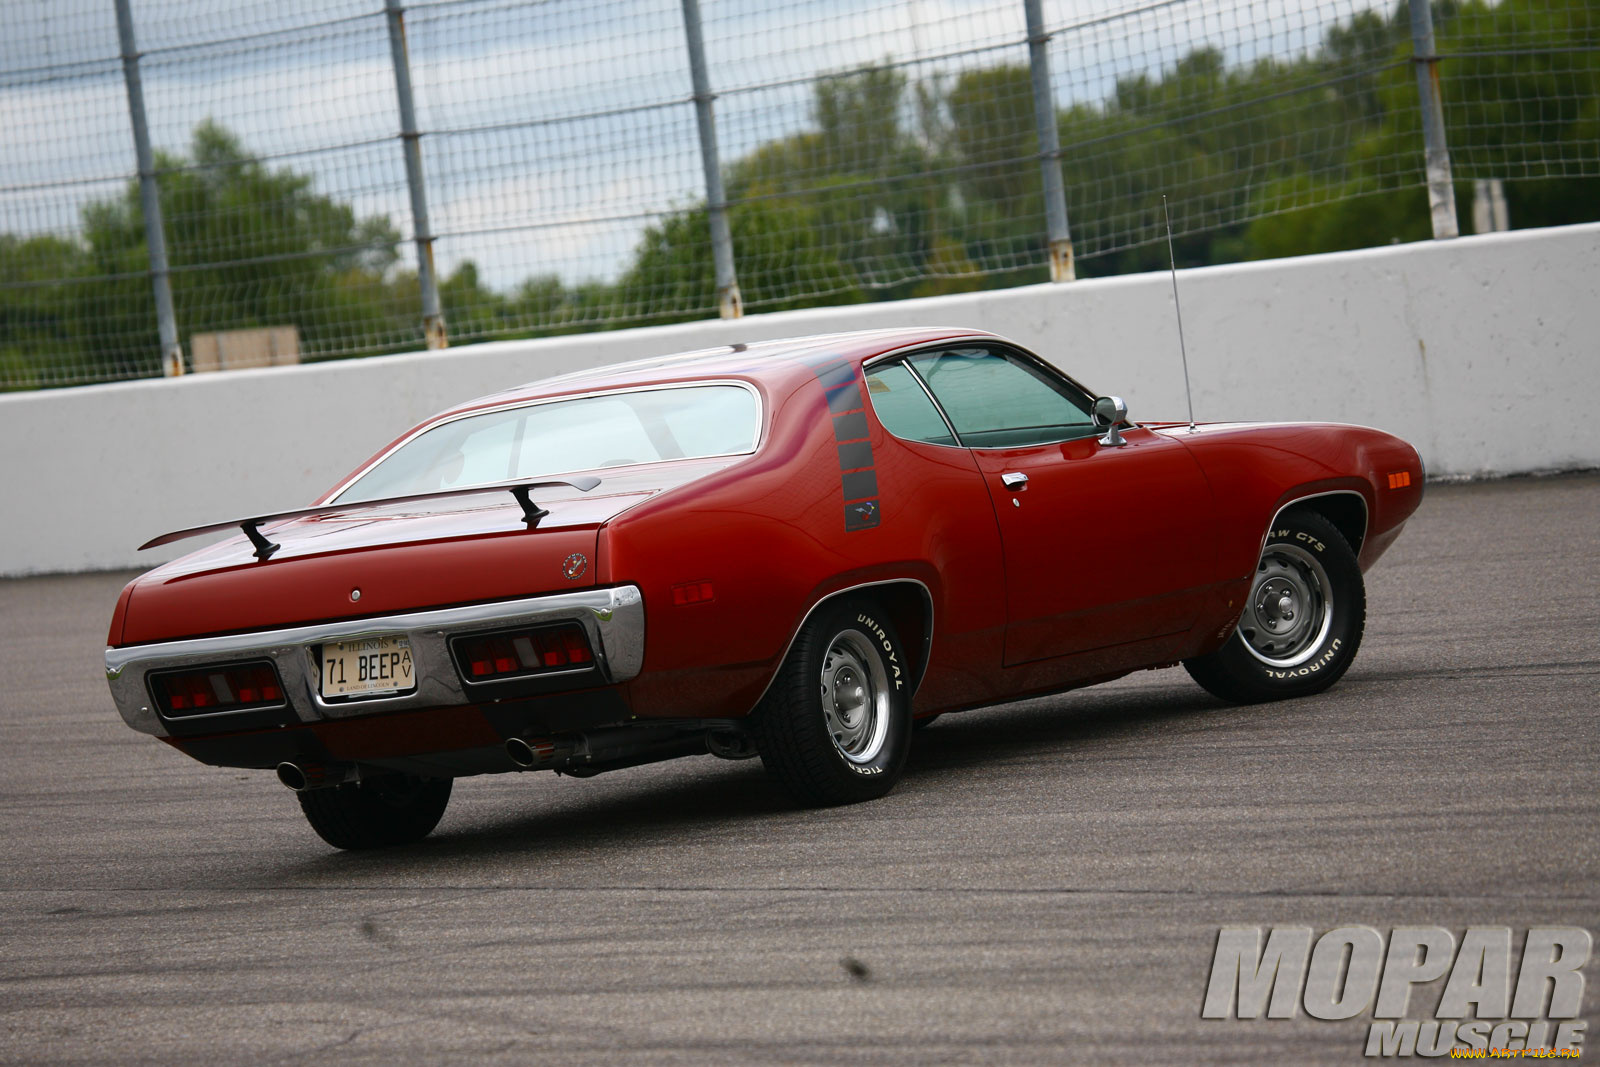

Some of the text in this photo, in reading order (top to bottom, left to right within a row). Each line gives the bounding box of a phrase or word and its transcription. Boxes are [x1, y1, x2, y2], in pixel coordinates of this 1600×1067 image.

[1295, 531, 1326, 552] GTS
[348, 640, 389, 652] ILLINOIS
[857, 613, 903, 690] UNIROYAL
[1266, 638, 1342, 679] UNIROYAL
[326, 652, 400, 685] 71 BEEP
[847, 761, 883, 775] TIGER
